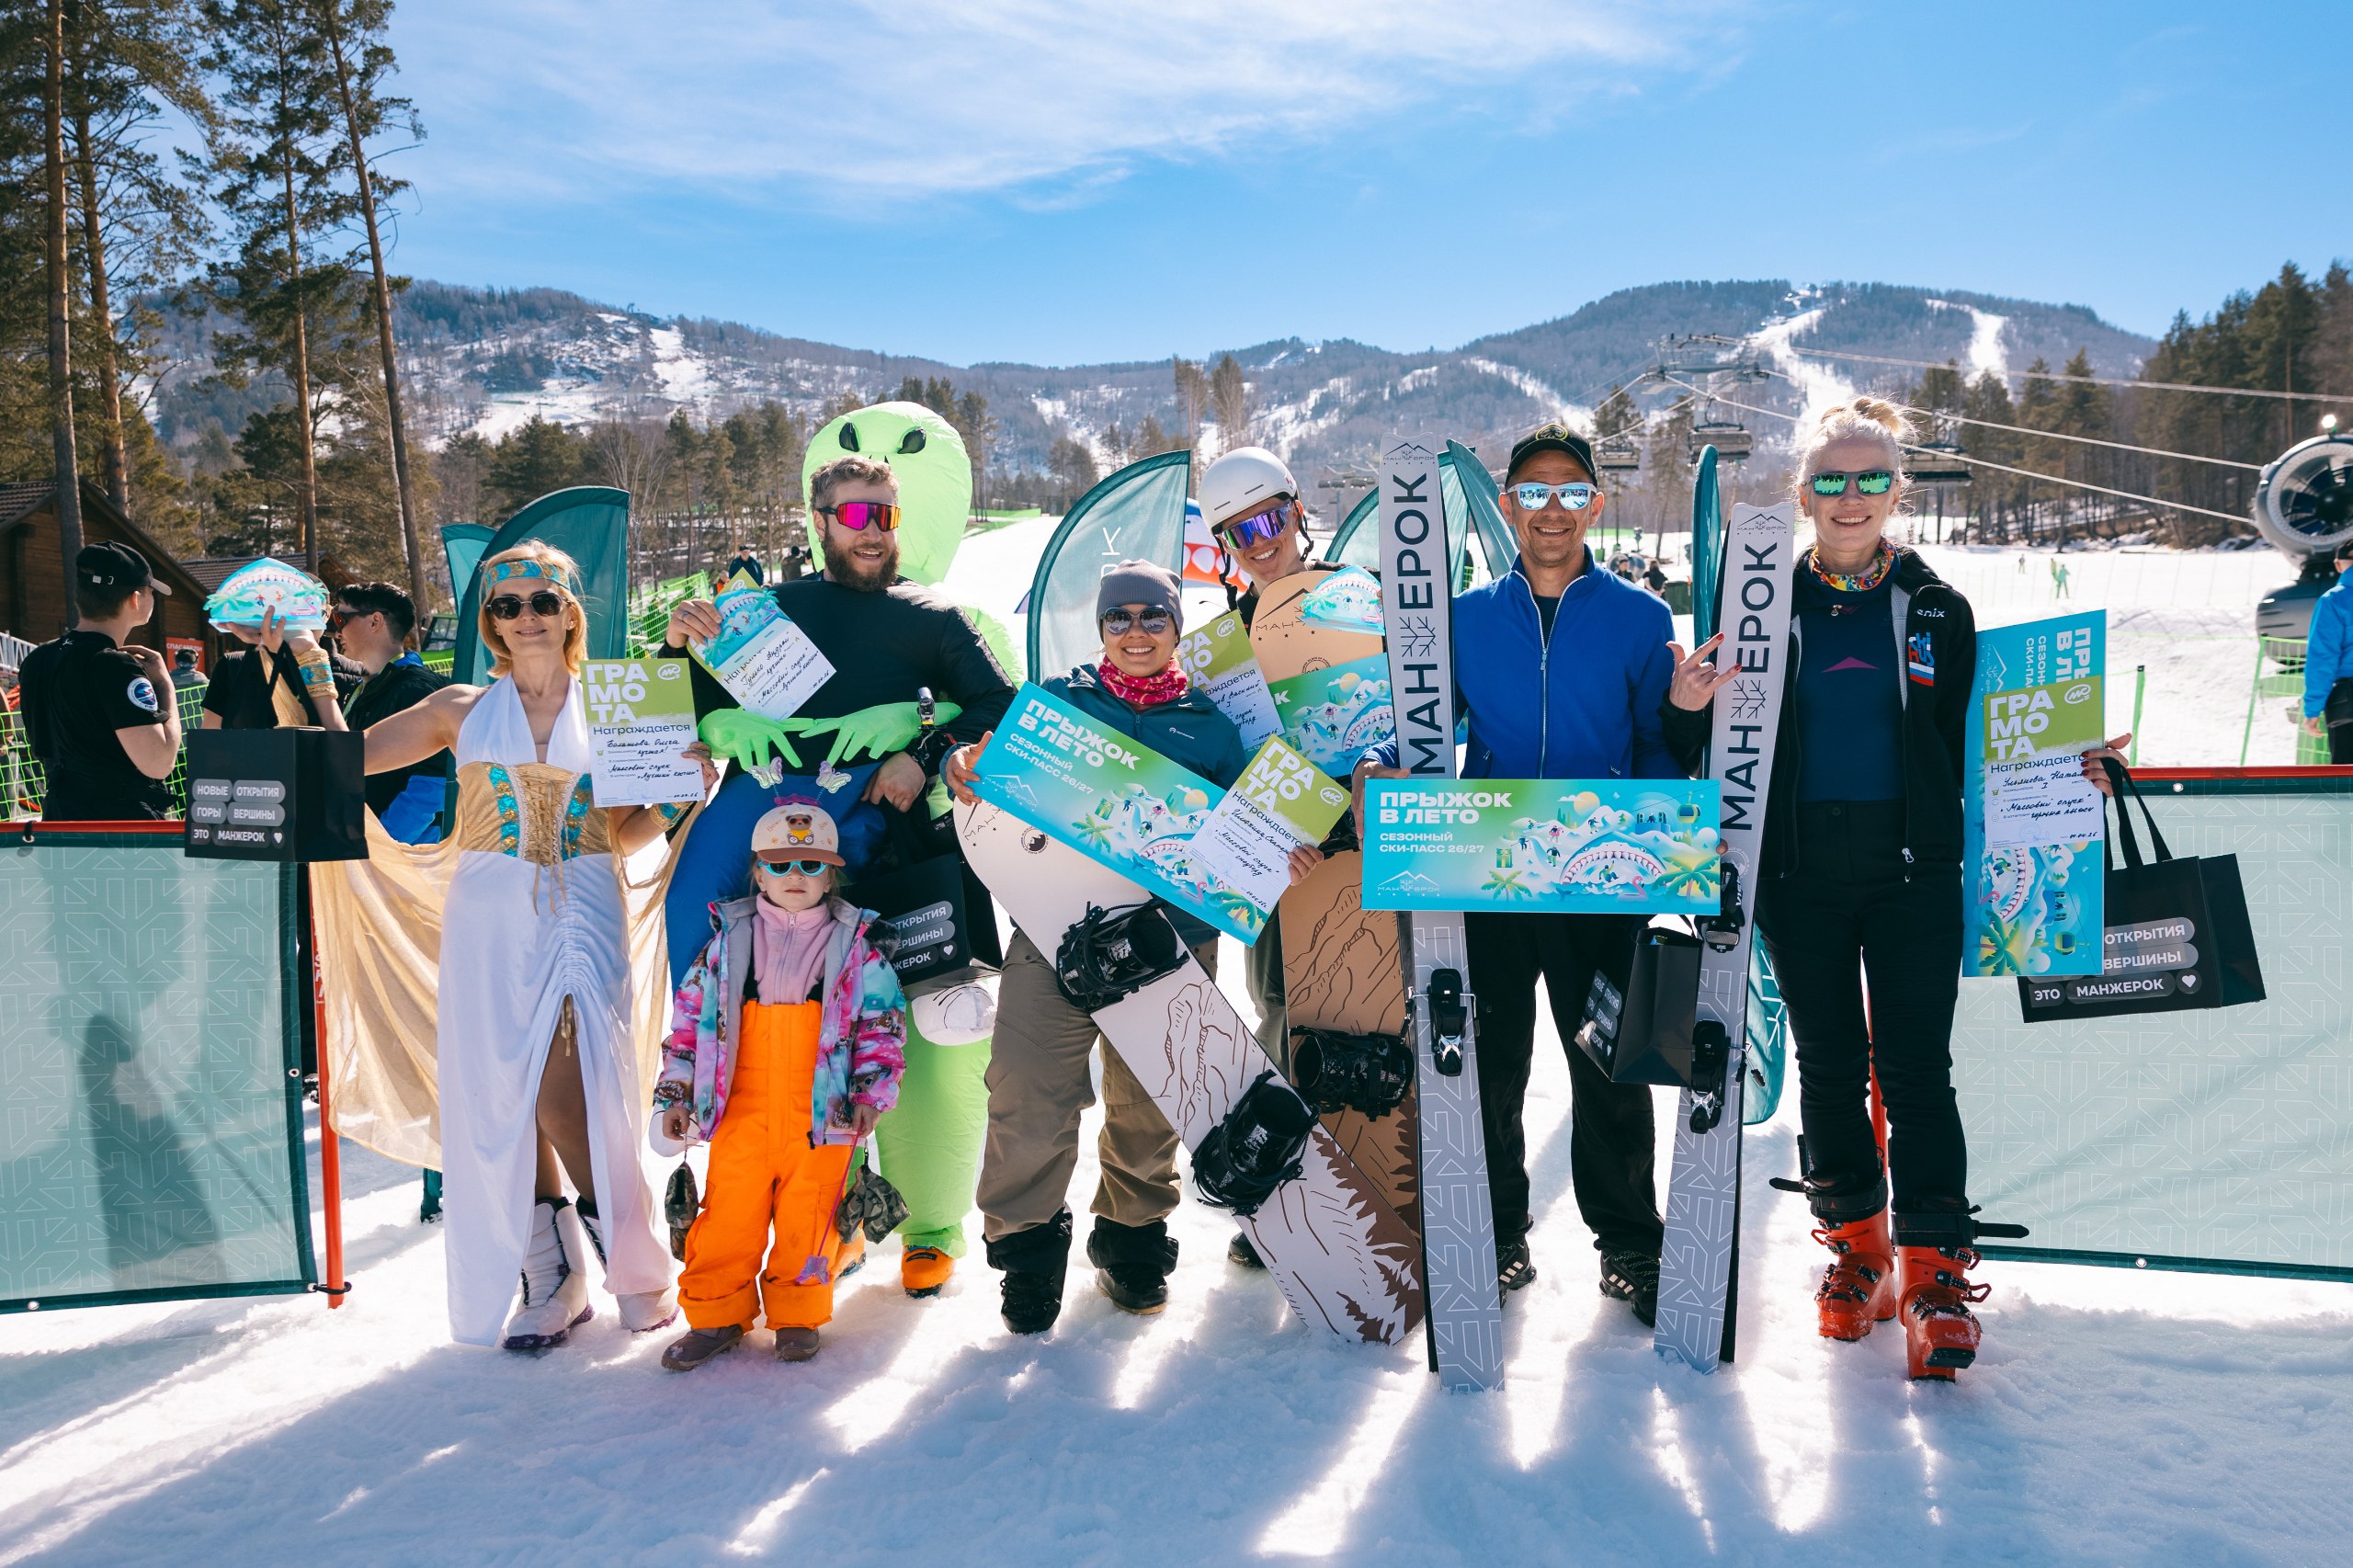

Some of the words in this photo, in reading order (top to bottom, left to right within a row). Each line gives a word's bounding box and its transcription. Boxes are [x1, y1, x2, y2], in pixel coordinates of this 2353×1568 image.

[1916, 608, 1945, 618] enix
[1178, 631, 1212, 658] РА
[2025, 638, 2035, 687] СКИ-ПА
[2038, 635, 2047, 686] СЕЗОНН
[585, 663, 650, 683] ГРА
[1205, 668, 1256, 697] аждается
[588, 683, 646, 703] МО
[1990, 689, 2054, 719] ГРА
[590, 704, 638, 723] ТА
[593, 724, 690, 735] Награждается
[1025, 699, 1141, 771] ПРЫЖОК
[1990, 711, 2049, 740] МО
[1017, 712, 1039, 732] В
[1038, 726, 1105, 767] ЛЕТО
[1991, 736, 2037, 760] ТА
[1010, 733, 1074, 772] СЕЗОННЫЙ
[1005, 743, 1062, 778] СКИ-ПАСС
[1061, 773, 1095, 795] 26/27
[1264, 741, 1315, 791] ГРА
[1991, 754, 2086, 774] Награждаетс
[2051, 770, 2084, 780] Натал
[1251, 757, 1302, 801] МО
[197, 785, 229, 796] НОВЫЕ
[236, 786, 280, 798] ОТКРЫТИЯ
[1245, 774, 1278, 814] ТА
[1380, 792, 1513, 808] ПРЫЖОК
[197, 807, 222, 818] ГОРЫ
[233, 808, 276, 821] ВЕРШИНЫ
[1232, 790, 1302, 847] Награждаетс
[1380, 809, 1400, 824] В
[1404, 809, 1480, 824] ЛЕТО
[193, 829, 210, 839] ЭТО
[218, 830, 266, 843] МАНЖЕРОК
[1380, 831, 1453, 841] СЕЗОННЫЙ
[1380, 844, 1446, 853] СКИ-ПАСС
[1448, 845, 1484, 854] 26/27
[895, 906, 947, 930] ТКРЫТИЯ
[897, 927, 944, 950] ЕРШИНЫ
[2105, 924, 2186, 945] ОТКРЫТИЯ
[892, 951, 931, 971] ЖЕРОК
[2104, 951, 2182, 970] ВЕРШИНЫ
[2034, 988, 2061, 1001] ЭТО
[2076, 979, 2165, 997] МАНЖЕРОК
